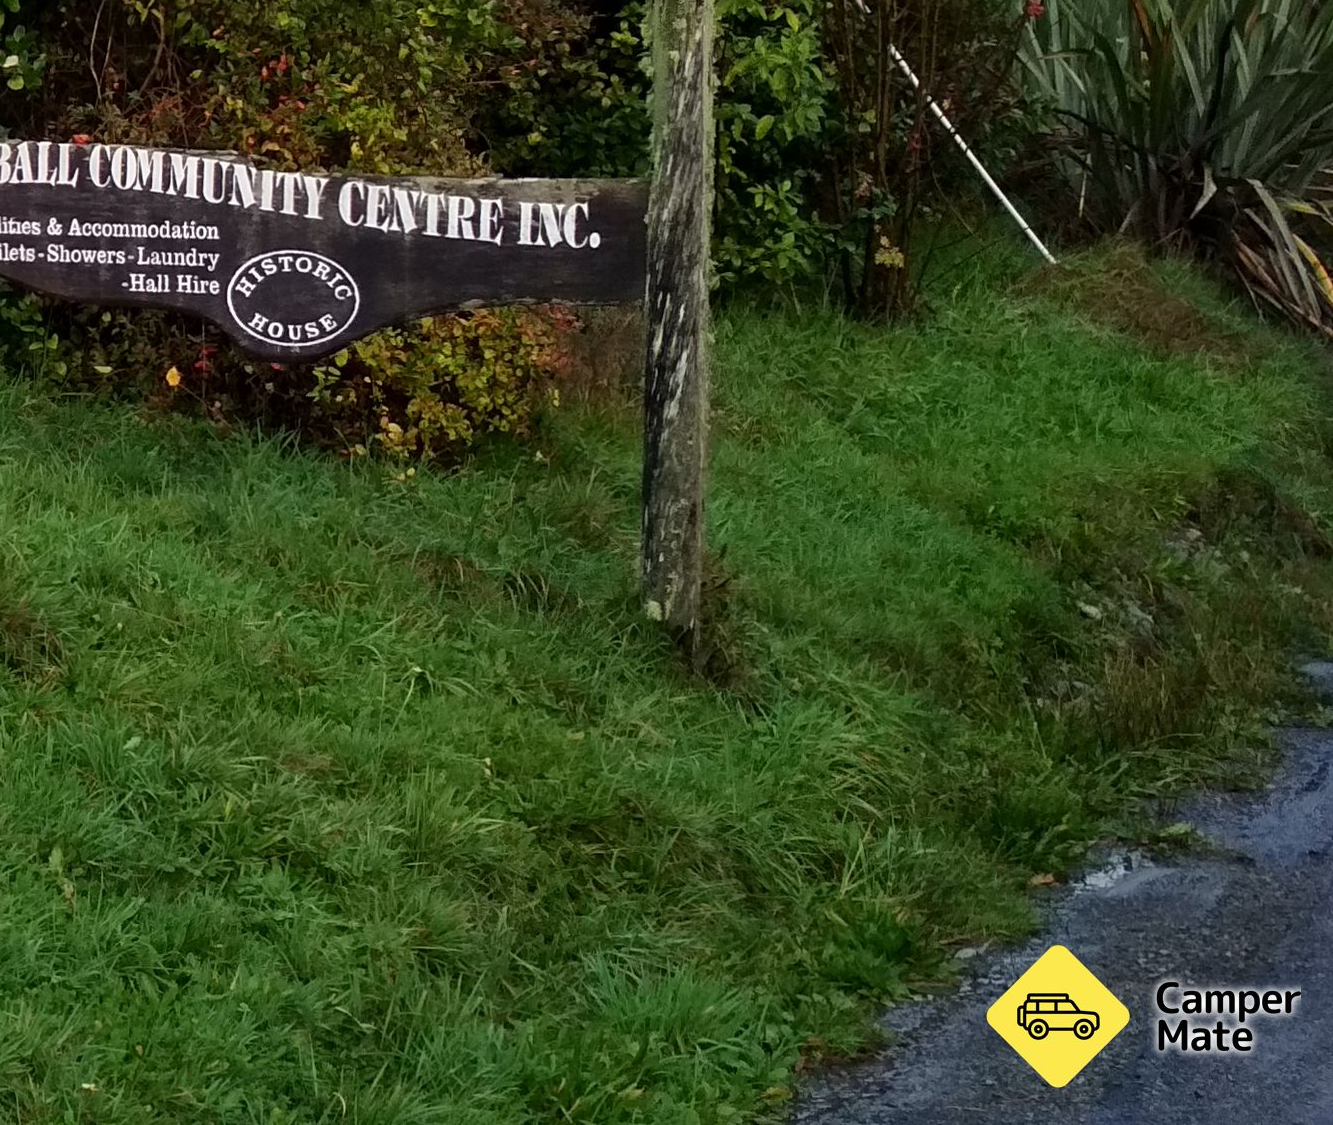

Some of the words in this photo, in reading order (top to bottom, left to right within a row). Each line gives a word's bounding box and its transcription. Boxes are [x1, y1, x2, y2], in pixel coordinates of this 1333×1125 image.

[89, 144, 330, 220] COMMUNITY
[338, 180, 505, 246] CENTRE
[517, 201, 602, 250] INC.
[47, 218, 63, 237] &
[68, 218, 220, 241] Accommodation
[177, 275, 220, 295] Hire
[235, 255, 353, 299] HISTORIC
[247, 311, 337, 341] HOUSE
